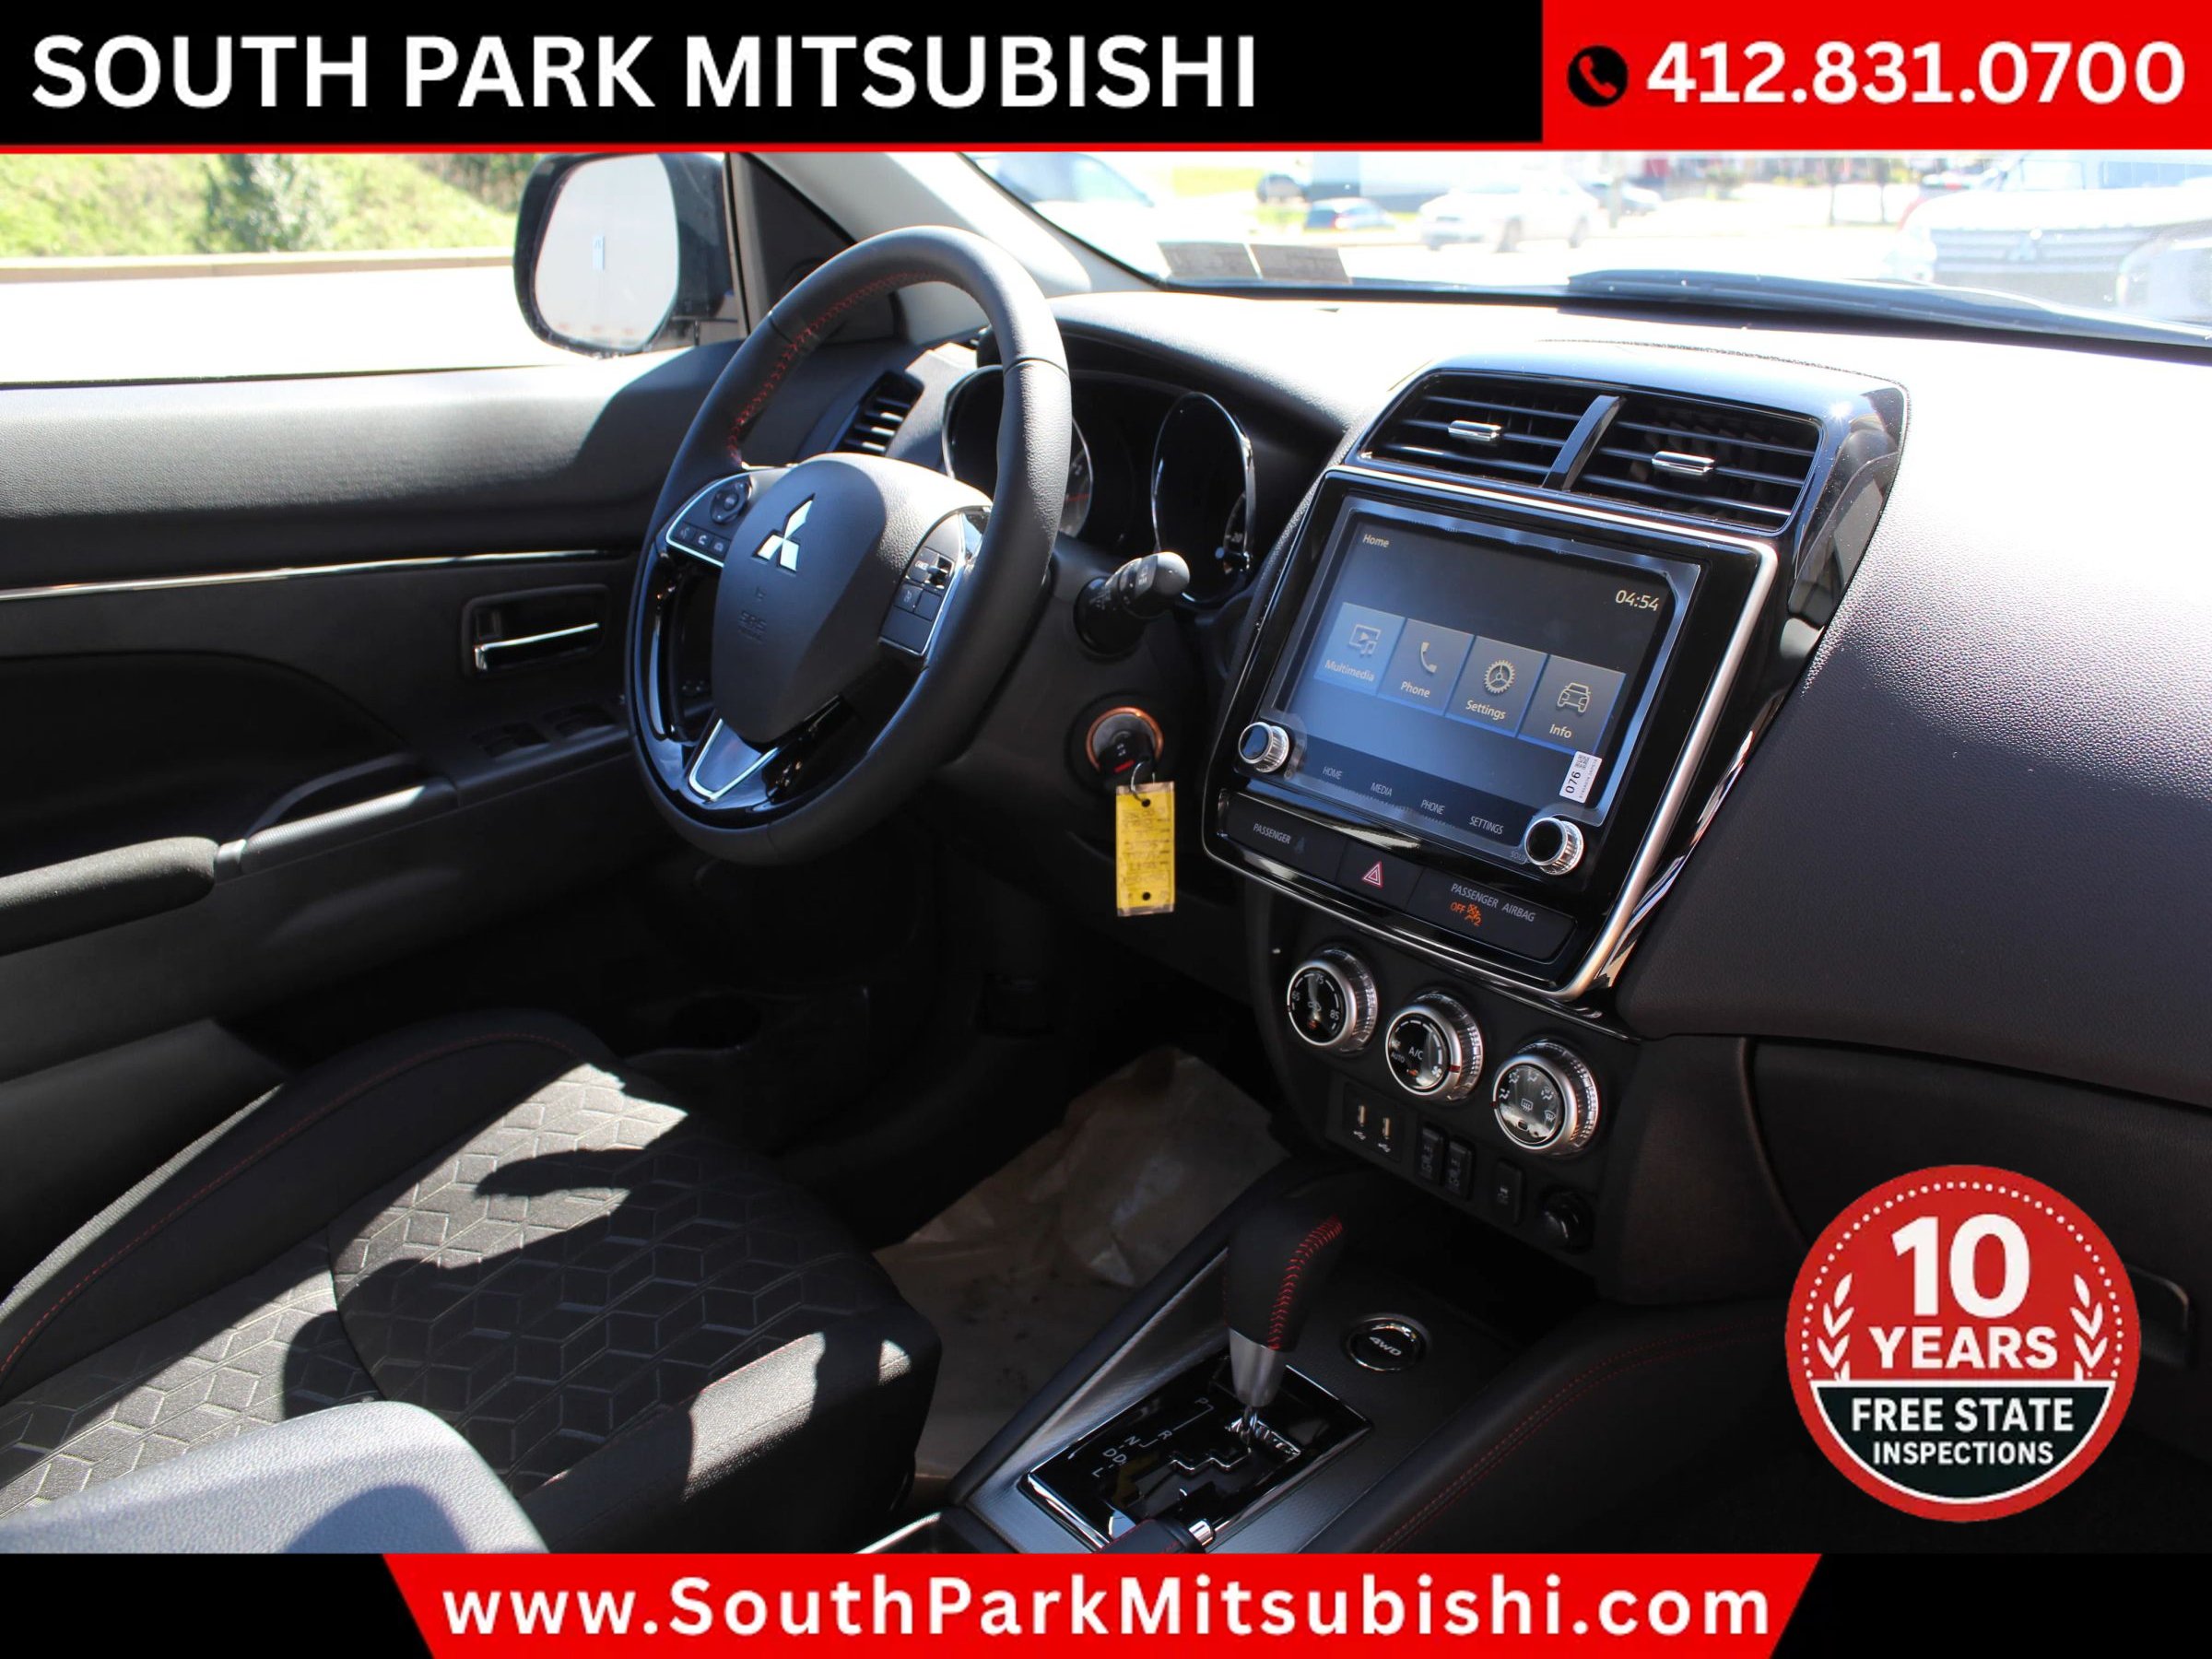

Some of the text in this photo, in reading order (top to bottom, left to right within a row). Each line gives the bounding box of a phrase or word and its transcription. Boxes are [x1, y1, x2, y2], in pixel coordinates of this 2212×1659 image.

[1362, 532, 1389, 549] Home
[1615, 590, 1660, 612] 04:54
[1324, 659, 1375, 684] Multimedia
[1400, 680, 1431, 700] Phone
[1465, 699, 1506, 722] Settings
[1549, 724, 1572, 739] Info
[1322, 766, 1343, 781] HOME
[1371, 782, 1394, 797] MEDIA
[1565, 771, 1581, 794] 076
[1420, 798, 1445, 816] PHONE
[1253, 822, 1292, 845] PASSENGER
[1469, 815, 1504, 835] SETTINGS
[1450, 882, 1536, 923] PASSENGER AIRBAG
[1450, 901, 1465, 914] OFF
[1330, 1008, 1340, 1020] 85
[1390, 1051, 1406, 1064] AUTO
[1408, 1046, 1424, 1060] A/C
[1369, 1336, 1402, 1357] 4WD
[1124, 1435, 1141, 1446] N
[1159, 1429, 1173, 1441] R
